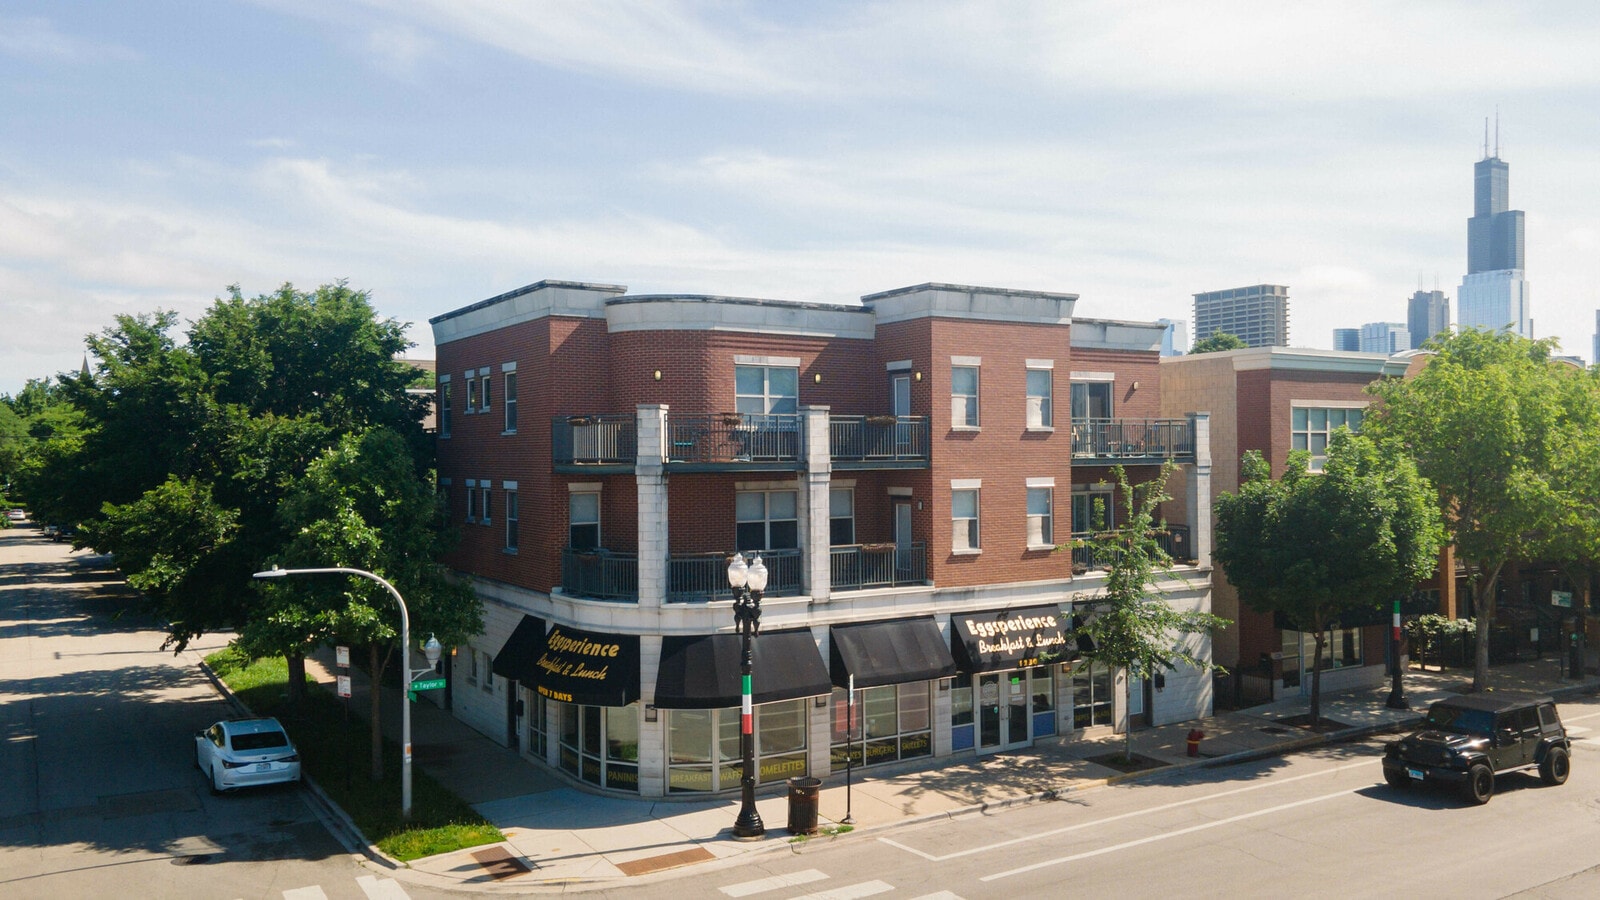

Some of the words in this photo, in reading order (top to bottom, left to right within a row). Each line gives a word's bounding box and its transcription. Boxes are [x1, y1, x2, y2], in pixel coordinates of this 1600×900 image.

[965, 614, 1057, 638] Eggsperience
[547, 629, 620, 657] Eggsperience
[978, 635, 1025, 655] Breakfast
[1025, 636, 1034, 648] &
[1035, 630, 1066, 647] Lunch
[570, 662, 609, 680] Lunch
[553, 691, 573, 702] DAYS
[865, 745, 896, 757] BURGERS
[760, 759, 806, 776] OMELETTES
[607, 770, 639, 784] PANINIS
[670, 773, 711, 784] BREAKFAST
